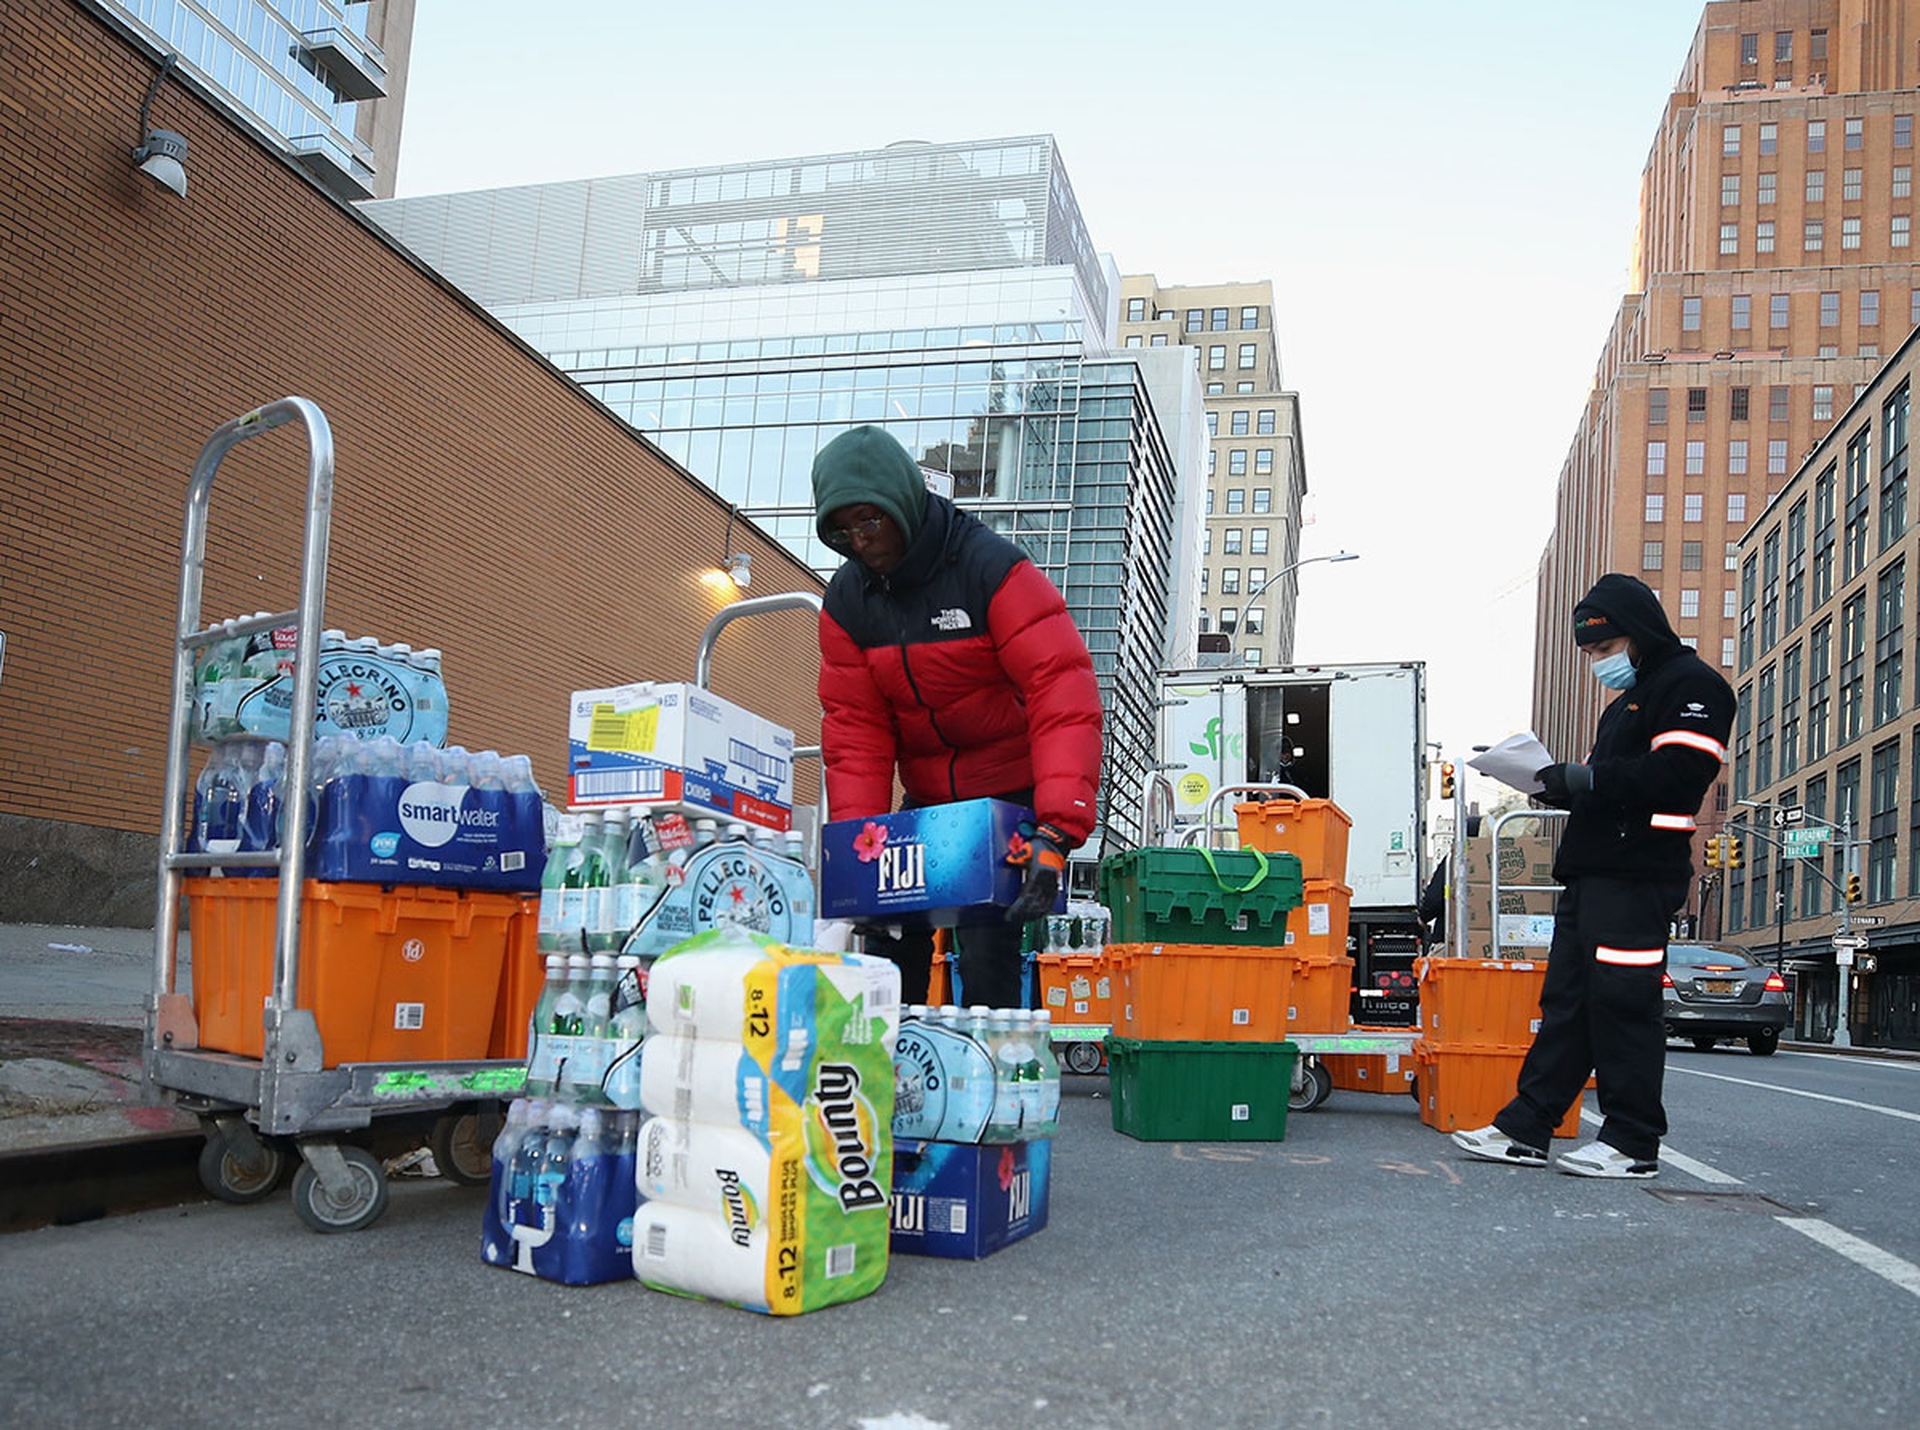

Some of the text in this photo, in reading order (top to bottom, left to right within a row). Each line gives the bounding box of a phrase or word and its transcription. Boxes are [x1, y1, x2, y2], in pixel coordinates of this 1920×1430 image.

[402, 803, 499, 828] smartwater
[698, 859, 784, 929] .PELLEGRINO
[878, 843, 925, 892] FIJI
[814, 1064, 886, 1212] Bounty
[714, 1167, 752, 1248] Bounty
[1008, 1171, 1030, 1223] FIJI
